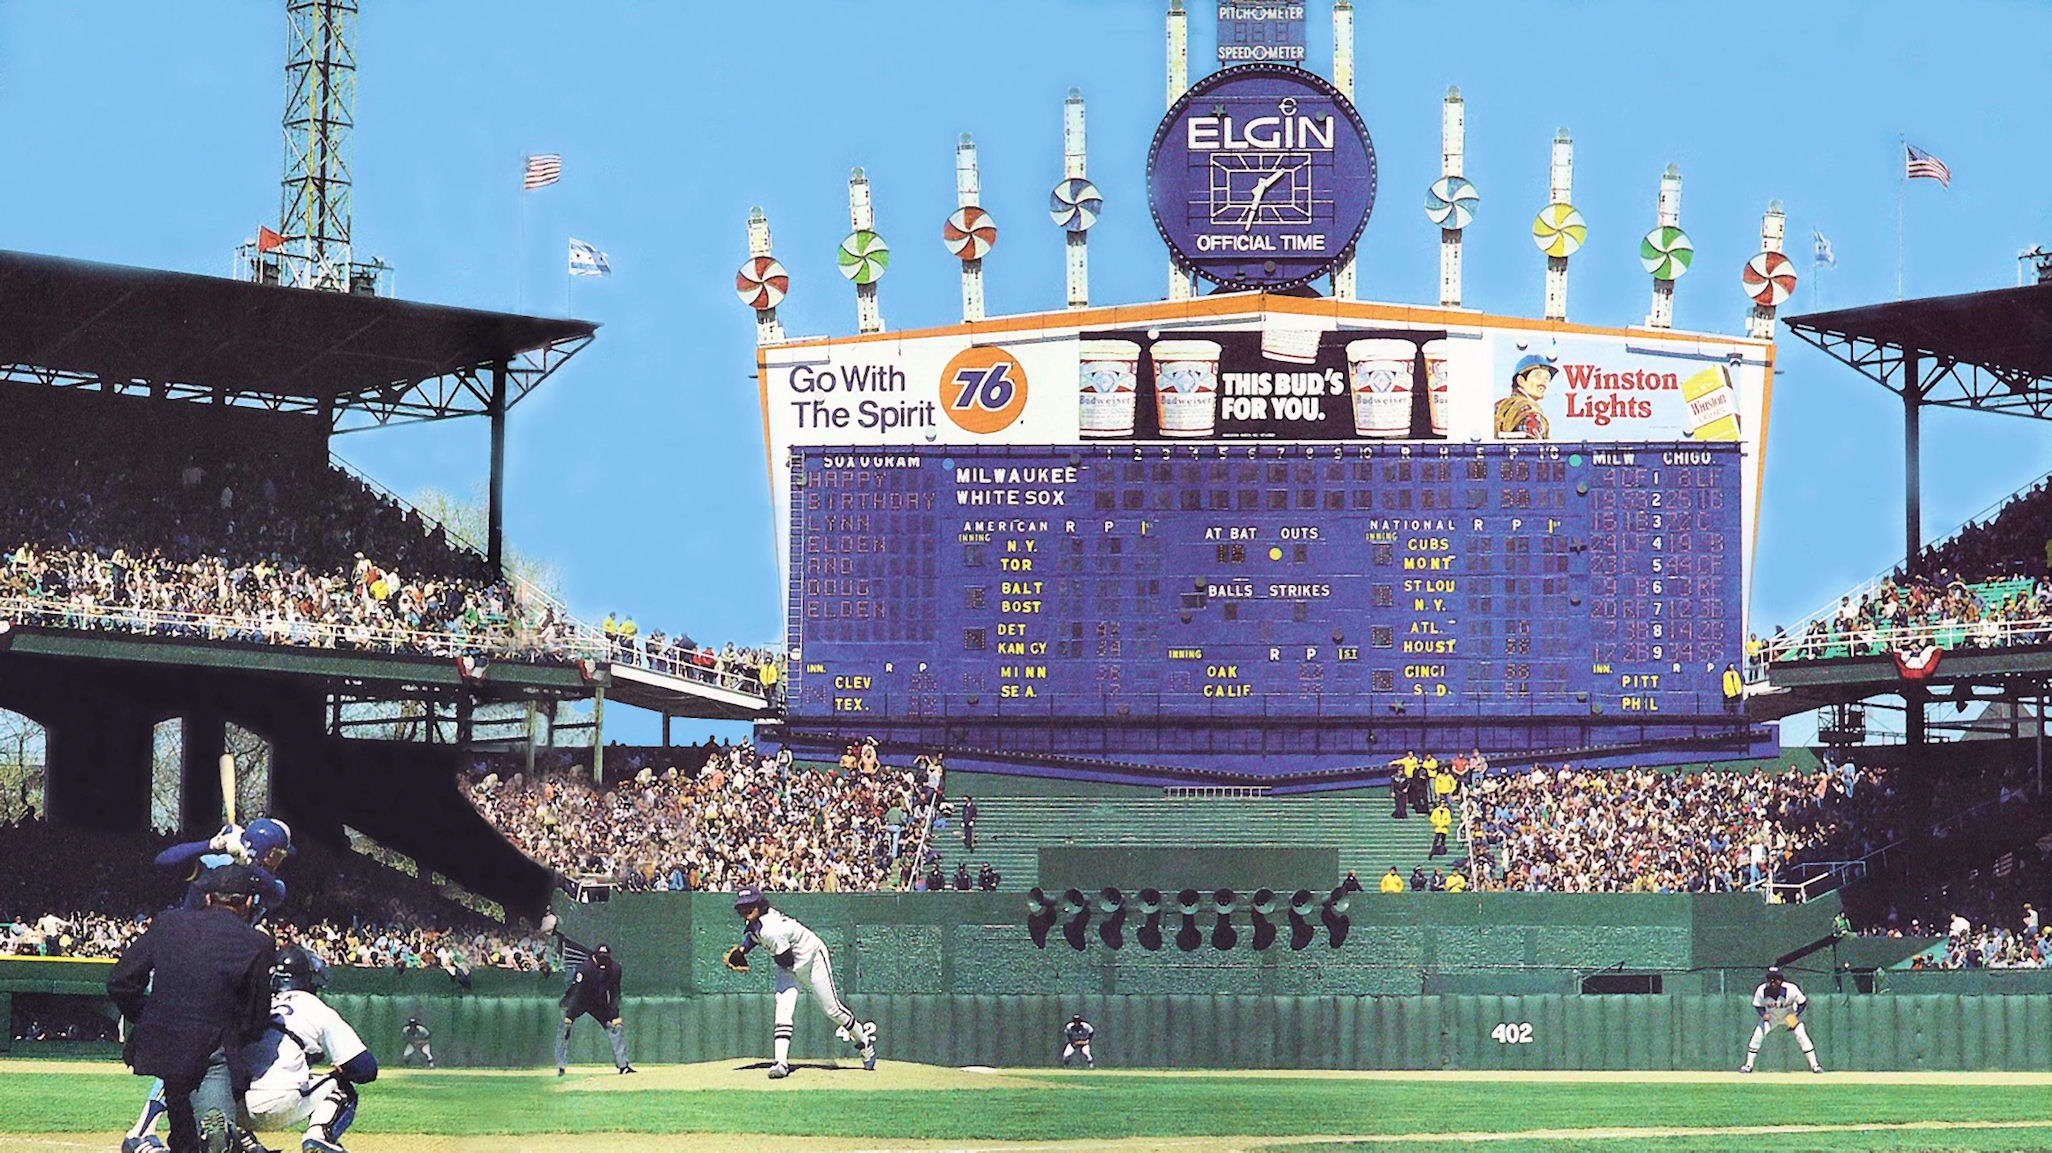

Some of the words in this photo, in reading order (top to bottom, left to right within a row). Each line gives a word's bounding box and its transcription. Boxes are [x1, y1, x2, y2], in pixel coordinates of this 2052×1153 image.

[1197, 235, 1276, 251] OFFICIAL
[1279, 235, 1325, 251] TIME
[789, 365, 836, 393] Go
[840, 365, 905, 392] With
[1222, 373, 1272, 396] THIS
[1273, 368, 1344, 396] BUD'S
[1563, 365, 1679, 390] Winston
[952, 363, 1015, 411] 76
[1222, 398, 1270, 420] FOR
[1271, 397, 1326, 420] YOU.
[1566, 393, 1652, 426] Lights
[790, 400, 850, 428] The
[857, 400, 936, 433] Spirit
[1593, 452, 1635, 465] MILW
[808, 471, 886, 487] HAPPY
[956, 468, 1077, 483] MILWAUKEE
[1654, 472, 1659, 485] 1
[808, 493, 935, 509] BIRTHDAY
[956, 490, 1020, 505] WHITE
[1023, 490, 1065, 506] SOX
[1653, 493, 1662, 507] 2
[808, 515, 869, 531] LYNN
[963, 520, 1048, 532] AMERICAN
[1066, 521, 1075, 532] R
[1105, 521, 1114, 532] P
[1370, 519, 1455, 531] NATIONAL
[1474, 519, 1483, 531] R
[1512, 519, 1521, 531] P
[1653, 515, 1662, 528] 3
[959, 533, 991, 542] INNING
[1205, 528, 1223, 540] AT
[1230, 528, 1257, 540] BAT
[1280, 528, 1319, 540] OUTS
[1366, 532, 1398, 541] INNING
[1408, 538, 1449, 550] CUBS
[1653, 537, 1662, 550] 4
[807, 558, 852, 573] AND
[1000, 559, 1032, 571] TOR
[1404, 557, 1451, 570] MONT
[1653, 559, 1662, 572] 5
[807, 579, 869, 595] DOUG
[1001, 582, 1043, 594] BALT
[1208, 585, 1253, 597] BALLS
[1269, 585, 1330, 597] STRIKES
[1404, 580, 1422, 592] ST
[1426, 580, 1455, 592] LOU
[1653, 583, 1662, 594] 6
[807, 600, 885, 617] ELDEN
[1001, 601, 1042, 613] BOST
[1653, 603, 1662, 615] 7
[998, 624, 1026, 635] DET
[1411, 622, 1444, 634] ATL.
[1653, 625, 1662, 638] 8
[998, 642, 1024, 655] KAN
[1030, 642, 1047, 655] CY
[1403, 640, 1456, 653] HOUST
[1653, 646, 1662, 659] 9
[1168, 649, 1202, 659] INNING
[1269, 648, 1280, 661] R
[1307, 648, 1317, 661] P
[886, 663, 893, 672] R
[919, 663, 927, 672] P
[1206, 666, 1238, 678] OAK
[1404, 665, 1445, 678] CINCI
[1673, 663, 1681, 673] R
[1707, 663, 1714, 673] P
[835, 676, 872, 689] CLEV
[1622, 675, 1659, 688] PITT
[835, 698, 870, 711] TEX.
[1622, 698, 1658, 711] PHIL
[576, 972, 583, 983] 9
[835, 1021, 877, 1042] 42
[1491, 1023, 1533, 1044] 402
